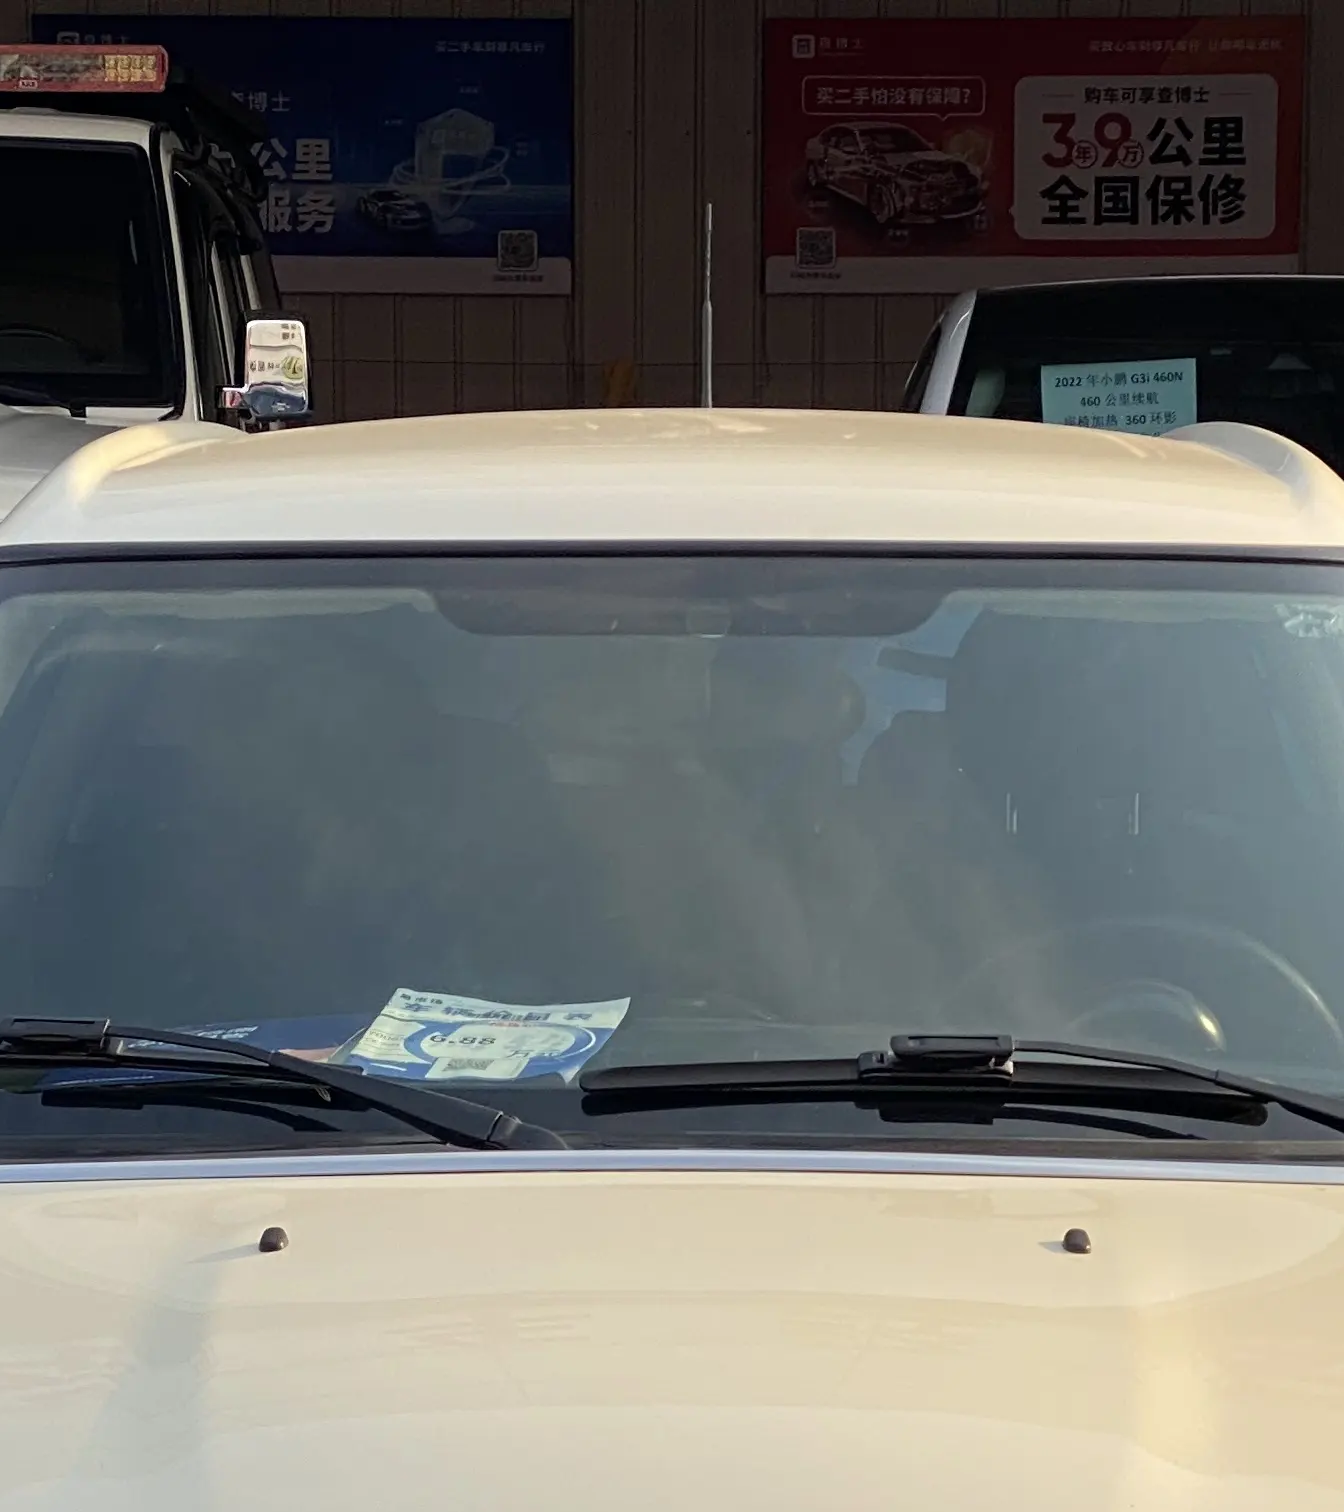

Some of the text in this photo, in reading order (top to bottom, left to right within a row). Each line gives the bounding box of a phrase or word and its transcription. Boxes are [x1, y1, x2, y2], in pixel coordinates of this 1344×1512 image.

[1084, 86, 1210, 105] 购车可享查博士
[1040, 174, 1247, 226] 全国保修
[1054, 376, 1083, 388] 2022
[1130, 373, 1150, 383] G3i
[1152, 371, 1184, 382] 460N
[1080, 396, 1101, 407] 460
[1125, 414, 1147, 425] 360
